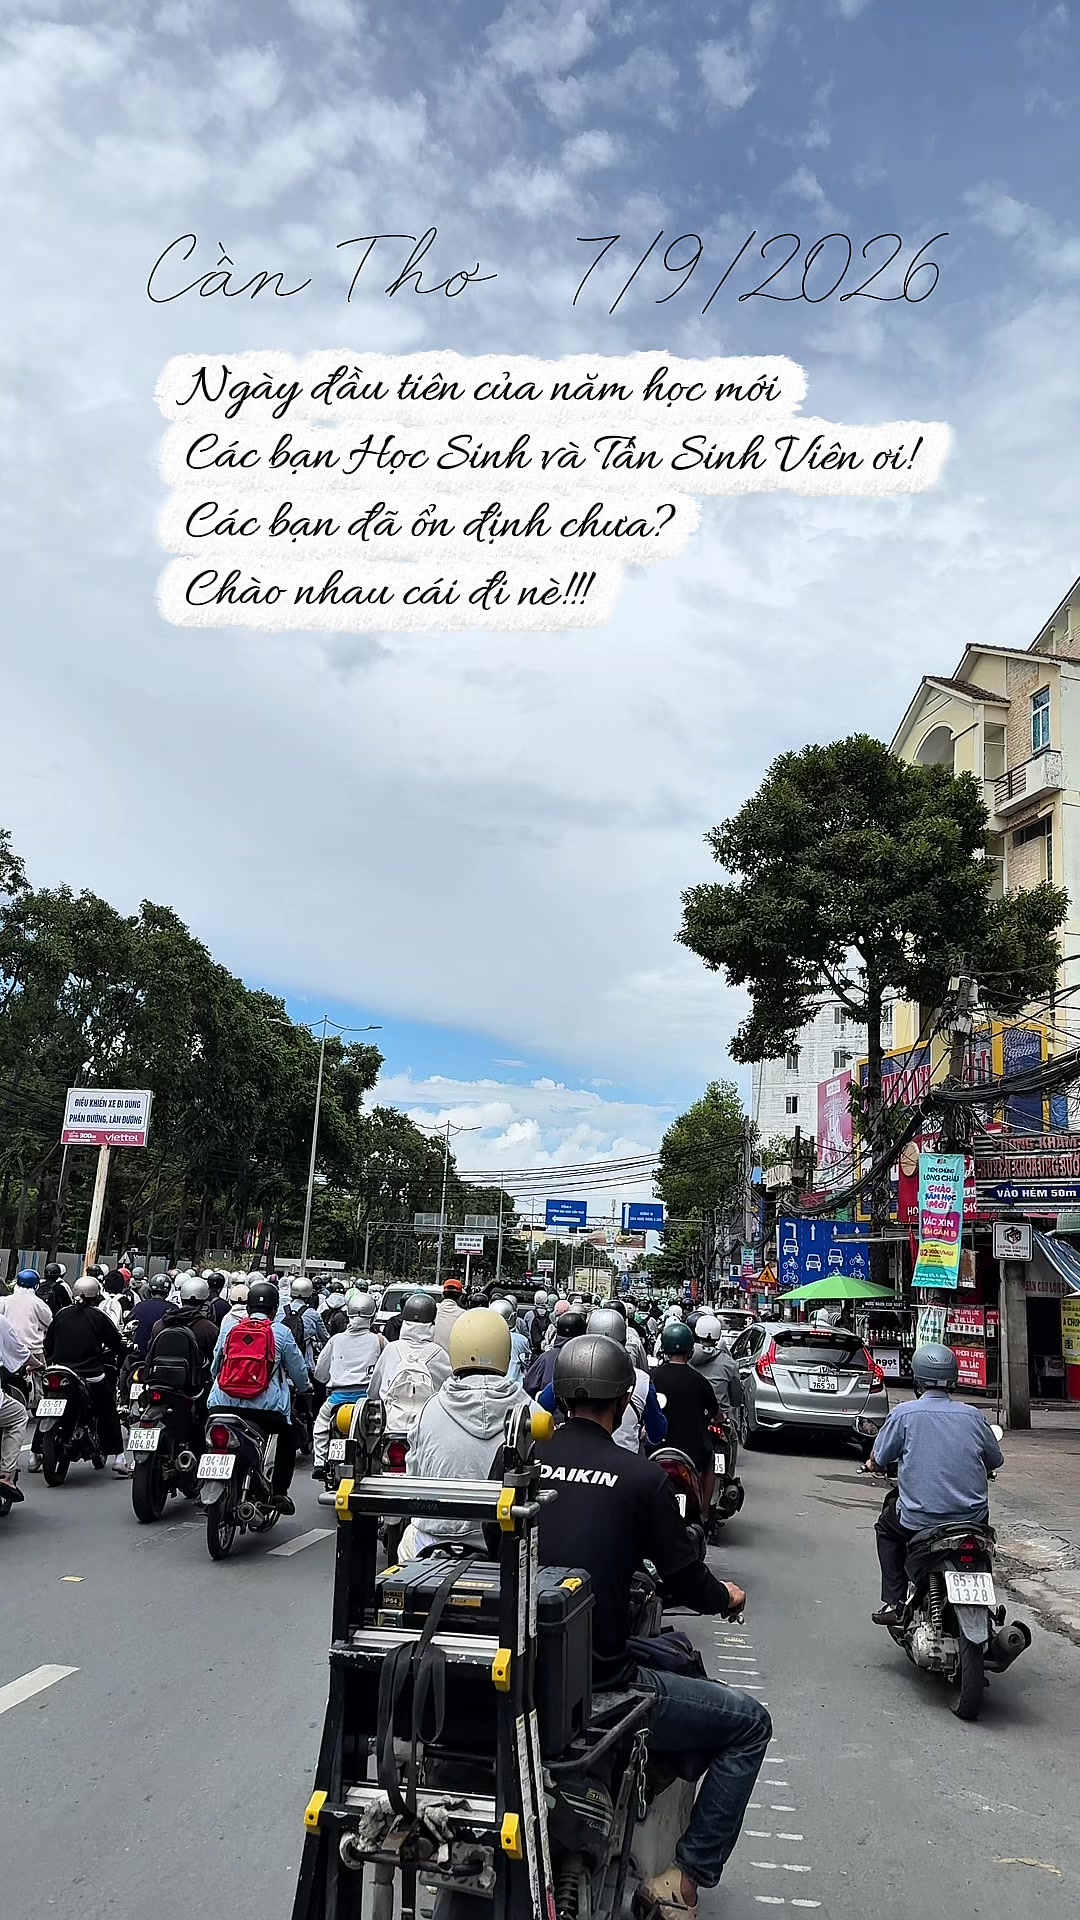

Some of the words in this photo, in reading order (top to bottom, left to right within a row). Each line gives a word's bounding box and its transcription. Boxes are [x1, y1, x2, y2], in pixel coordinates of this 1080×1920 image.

[108, 1100, 116, 1108] XE
[105, 1134, 138, 1142] viettel
[997, 1188, 1018, 1198] VÀO
[942, 1194, 956, 1202] HỌC
[938, 1219, 954, 1227] XIN
[876, 1358, 897, 1366] ngọt
[134, 1431, 154, 1439] 64-FA
[540, 1464, 618, 1488] DAIKIN
[956, 1588, 988, 1602] 1328
